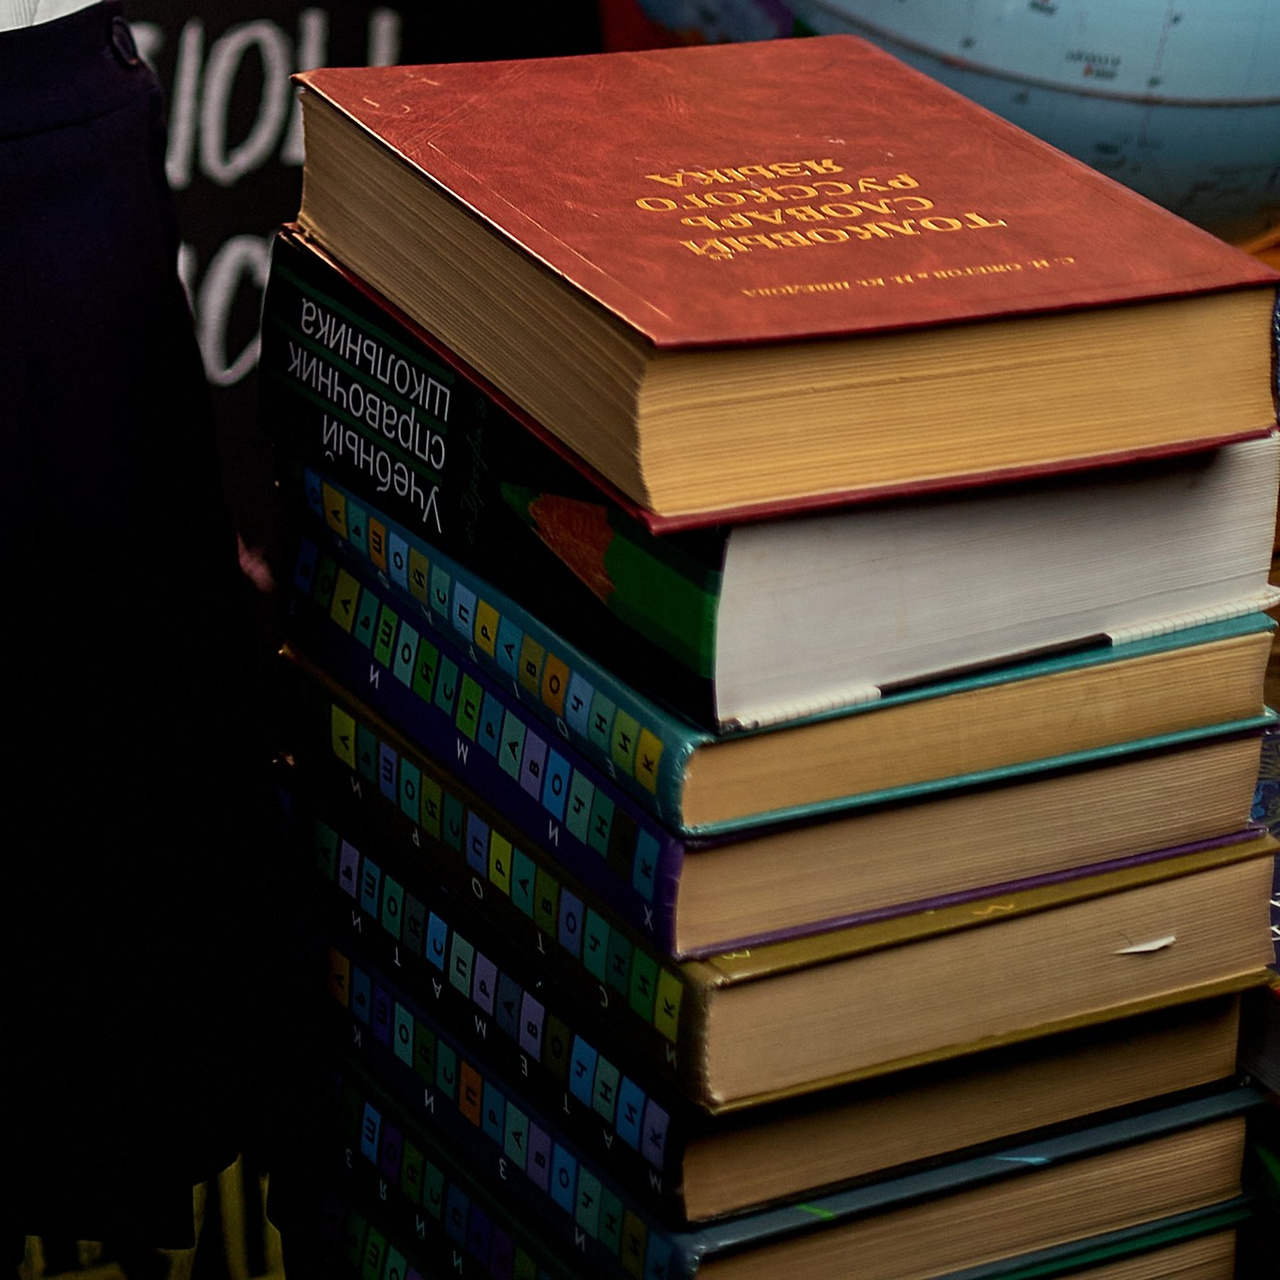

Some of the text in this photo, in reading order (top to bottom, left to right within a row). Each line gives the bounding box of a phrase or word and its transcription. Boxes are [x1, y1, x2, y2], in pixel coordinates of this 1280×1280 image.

[634, 173, 921, 213] РУССКОГО
[644, 157, 845, 189] ЯЗЫКА
[679, 195, 935, 231] СЛОВАРЬ
[679, 211, 1007, 261] ТОЛКОВЫЙ
[287, 339, 446, 470] справочник
[300, 297, 451, 424] школьника
[323, 414, 443, 535] Учебный
[350, 776, 677, 1070] ИСТОРИ
[352, 909, 663, 1195] МАТЕМАТИ
